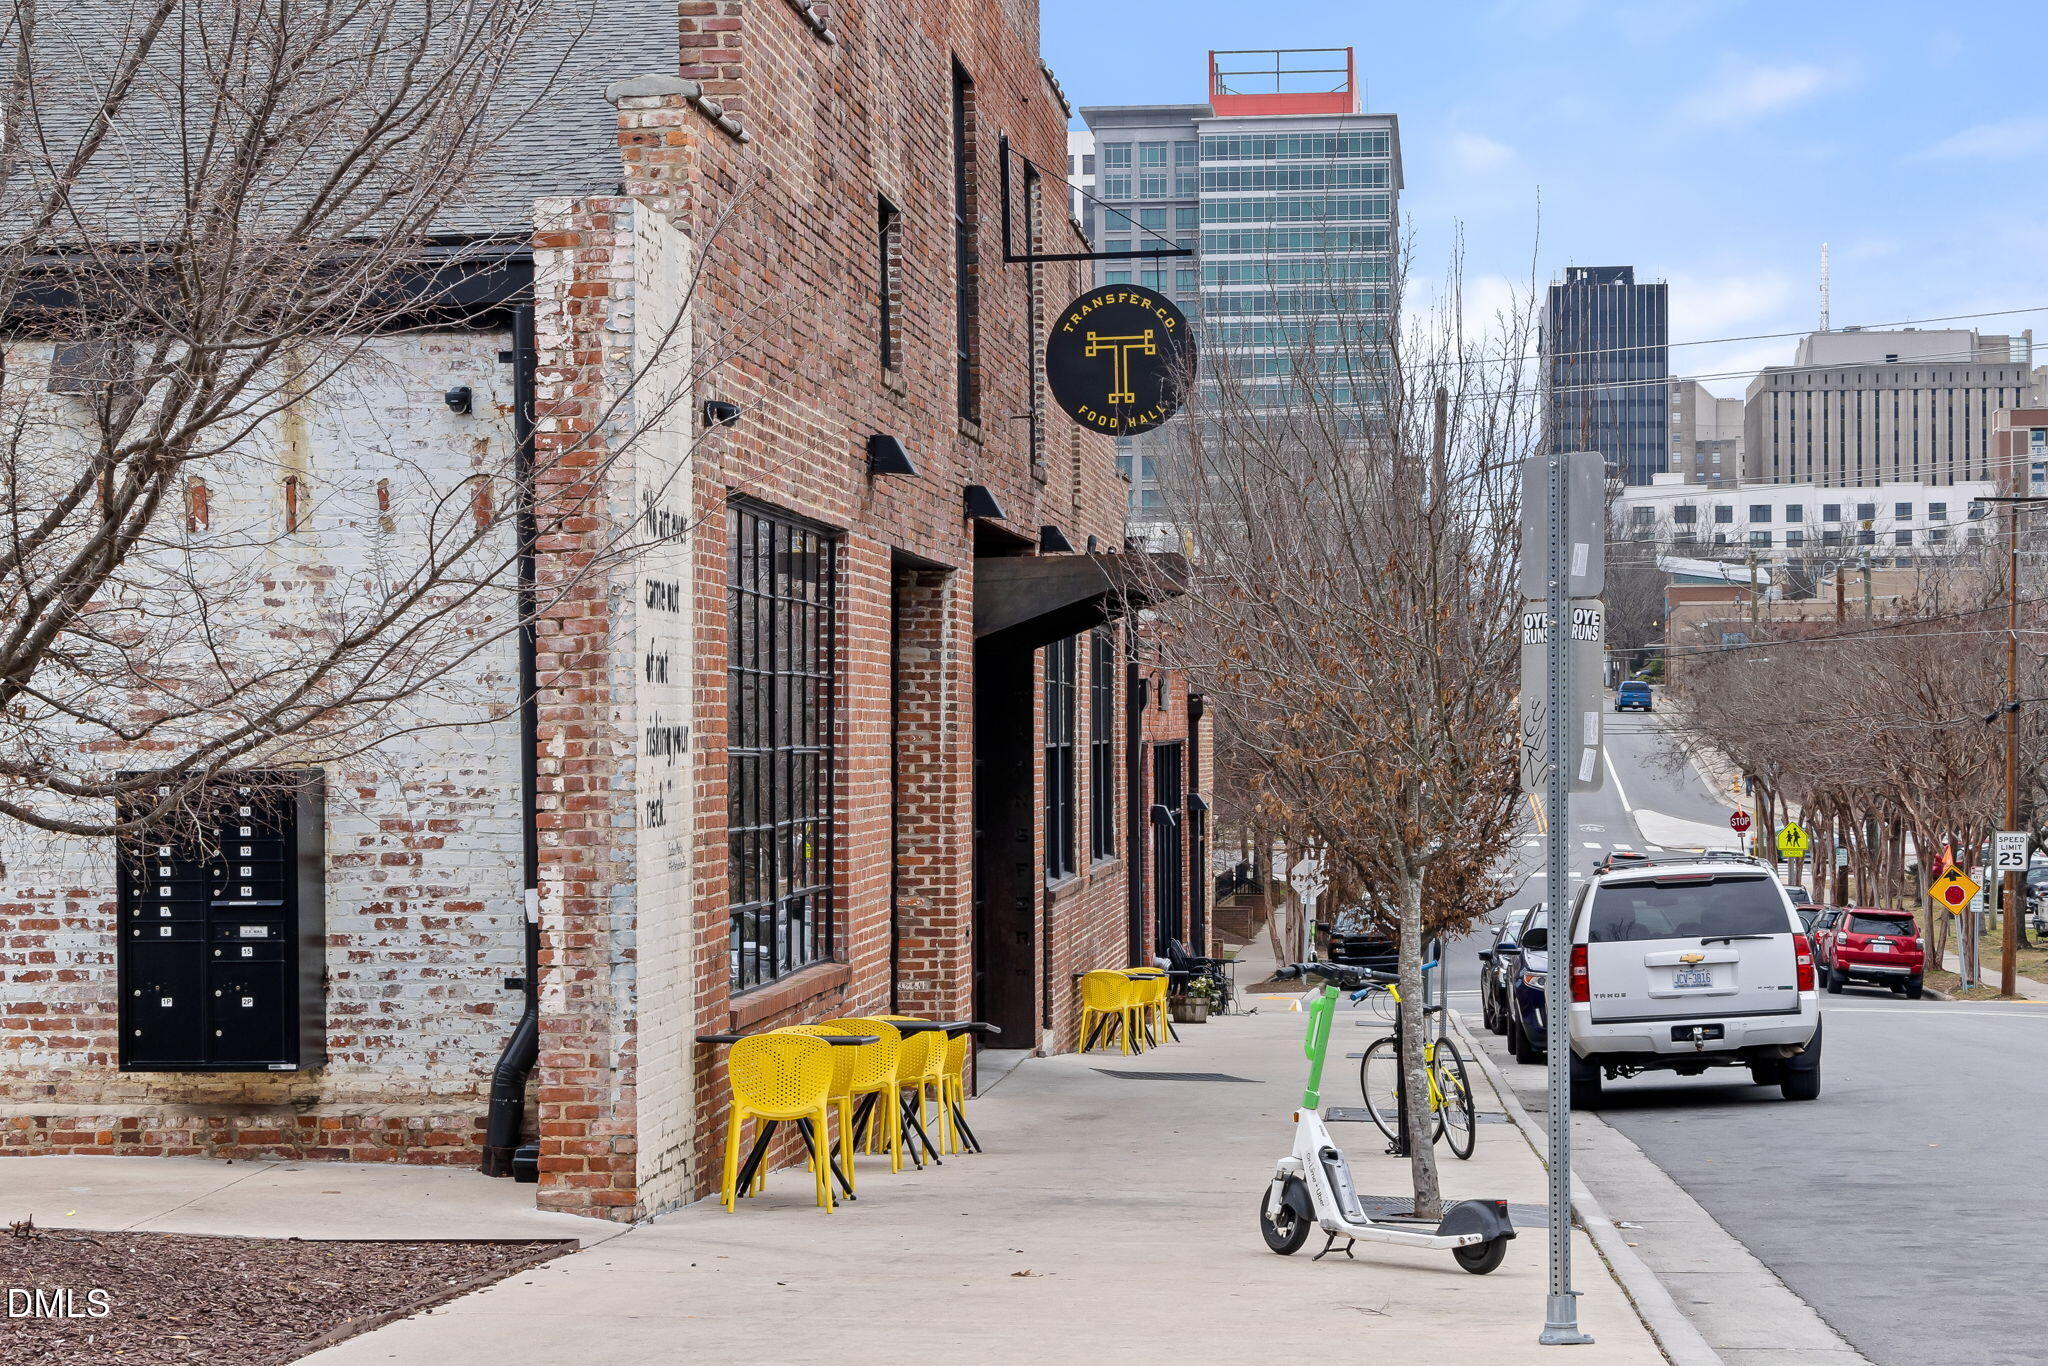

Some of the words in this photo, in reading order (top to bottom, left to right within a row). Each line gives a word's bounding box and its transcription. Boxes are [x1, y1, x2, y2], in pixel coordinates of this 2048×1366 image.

[1063, 293, 1153, 333] TRANSFER
[1155, 307, 1177, 333] CO.
[1078, 404, 1118, 428] FOOD
[1128, 403, 1167, 428] HALL
[659, 504, 670, 541] art
[671, 513, 688, 545] ever
[645, 578, 666, 612] came
[667, 578, 680, 614] out
[1523, 613, 1548, 629] OYE
[1573, 608, 1600, 626] OYE
[1571, 624, 1599, 642] RUNS
[645, 637, 655, 684] of
[655, 648, 669, 685] not
[646, 710, 672, 767] risking
[672, 725, 689, 767] your
[1731, 817, 1750, 826] STOP
[1998, 852, 2024, 866] 25
[1674, 972, 1711, 984] JCV-3816
[162, 998, 171, 1006] 1P
[242, 998, 251, 1006] 2P
